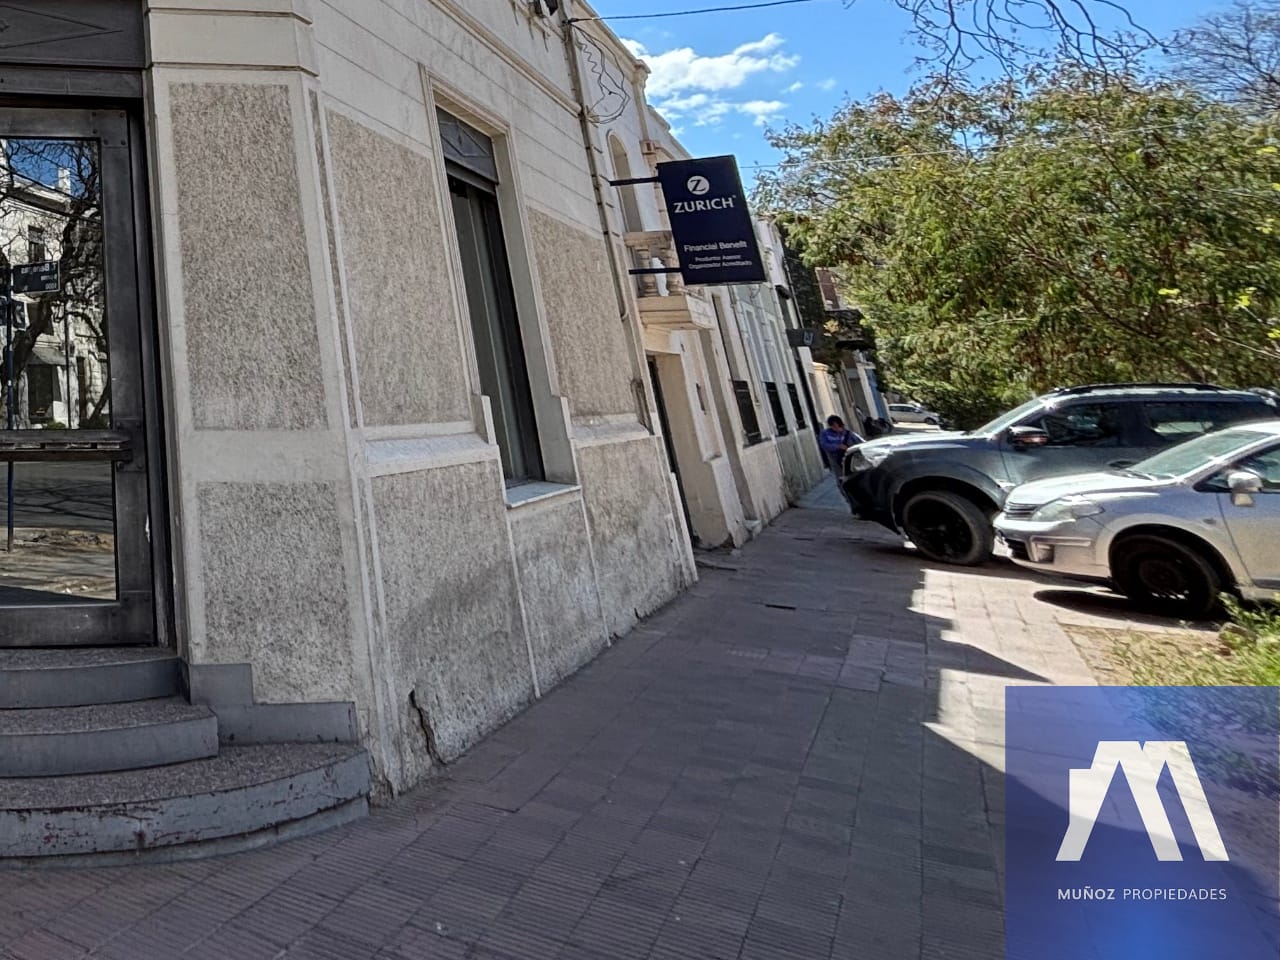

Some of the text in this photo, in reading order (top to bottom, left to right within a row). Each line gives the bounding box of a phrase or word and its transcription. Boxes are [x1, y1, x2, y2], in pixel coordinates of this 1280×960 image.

[674, 197, 734, 213] ZURICH
[684, 241, 748, 253] Financial Benefit
